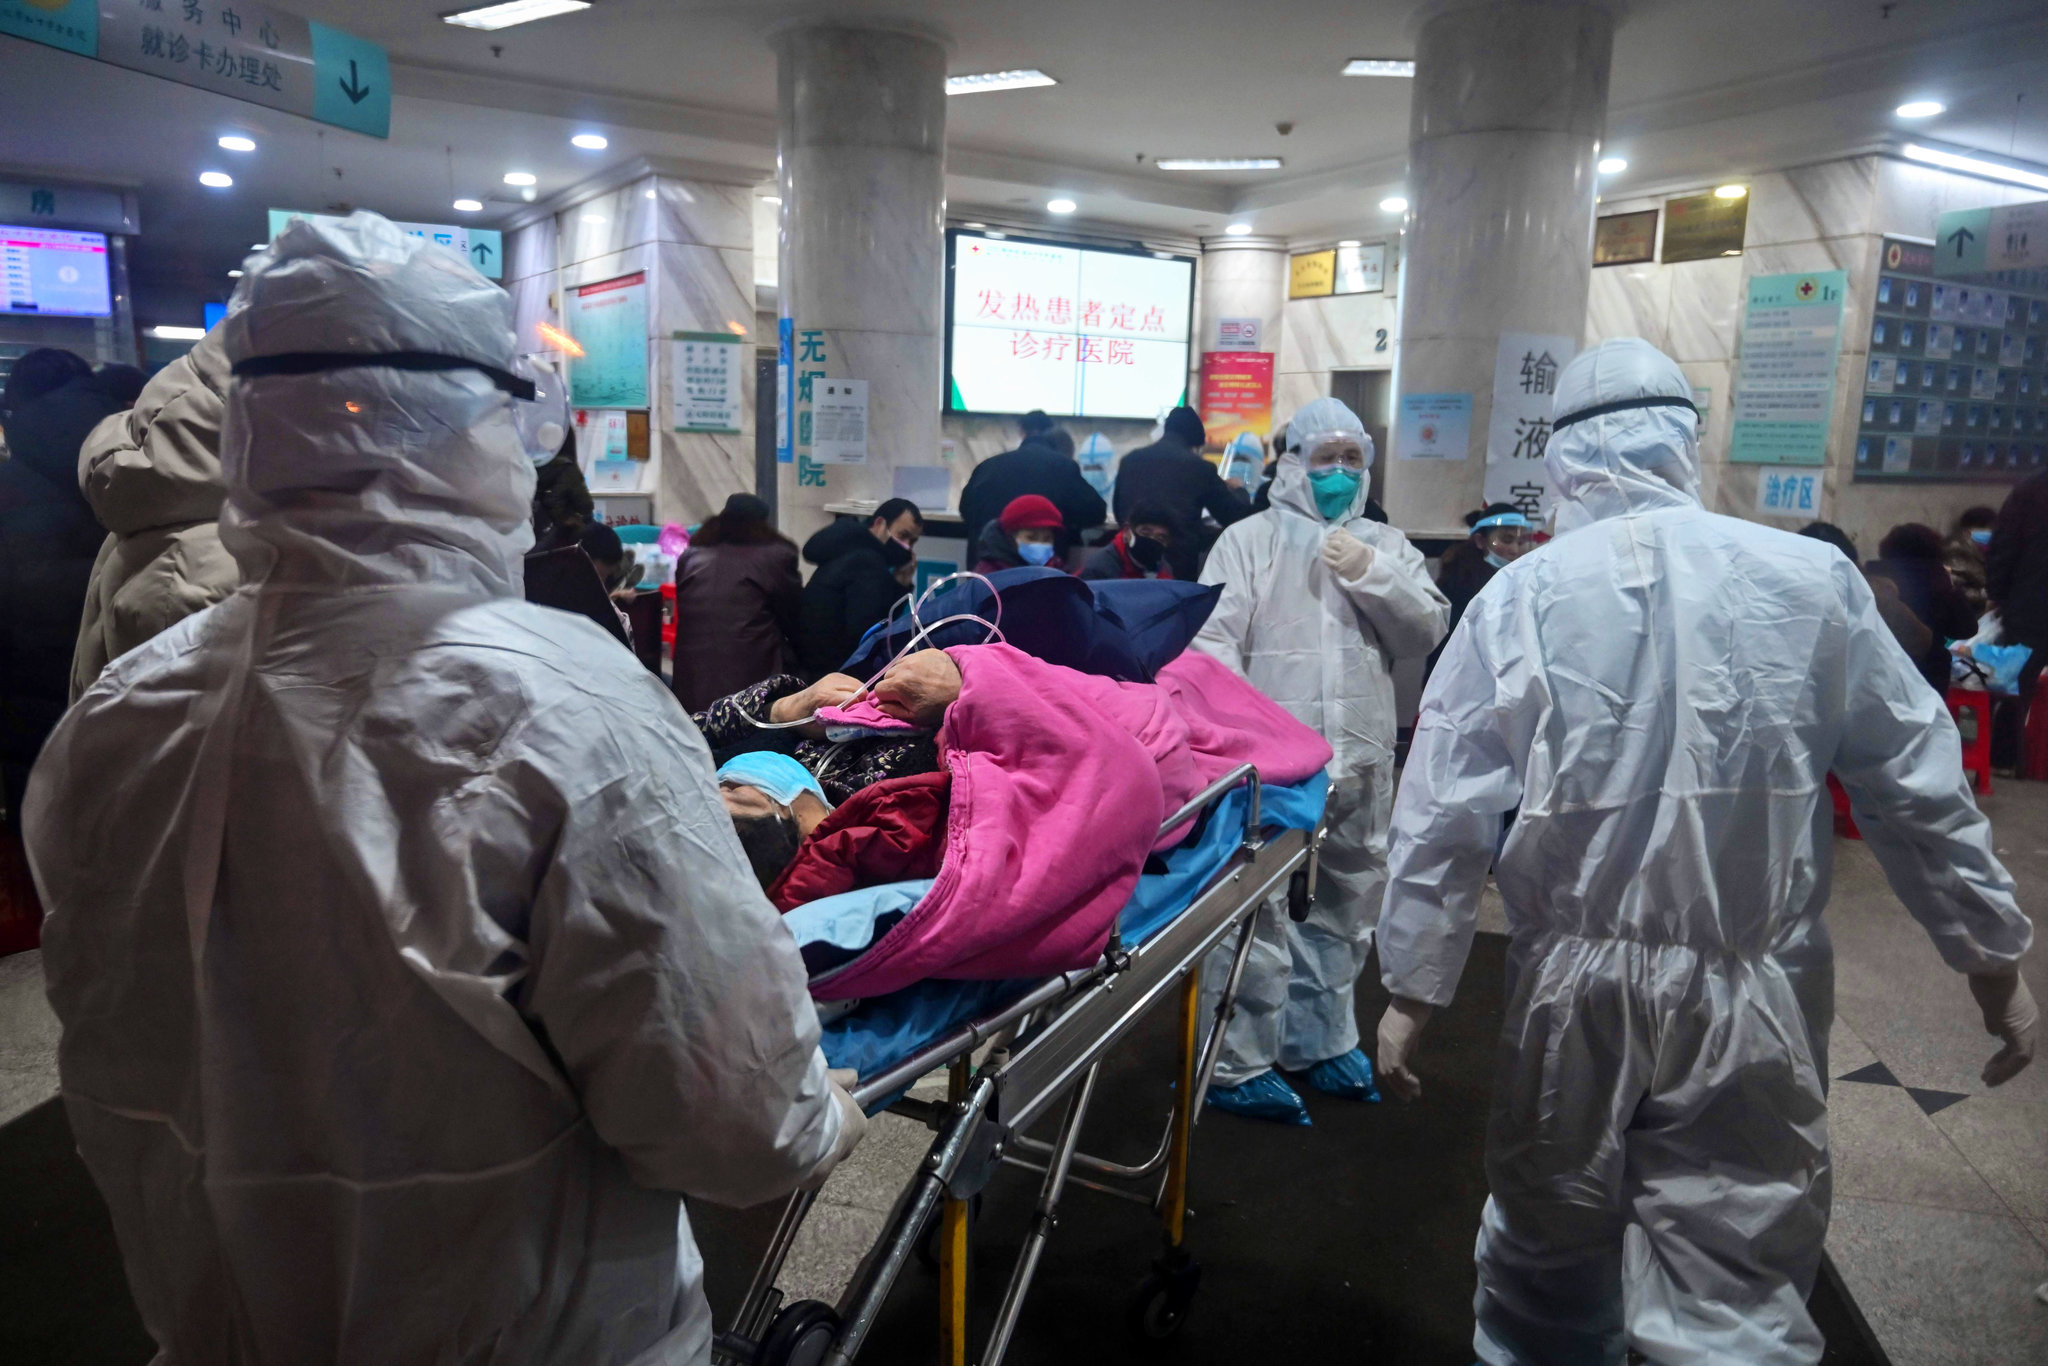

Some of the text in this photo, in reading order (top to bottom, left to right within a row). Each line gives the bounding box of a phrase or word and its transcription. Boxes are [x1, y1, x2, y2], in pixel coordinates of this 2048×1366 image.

[141, 25, 281, 91] 就诊卡办理处
[976, 289, 1165, 332] 发热患者定点
[1009, 330, 1134, 365] 诊疗医院
[1375, 329, 1388, 351] 2
[1511, 351, 1557, 521] 输液室
